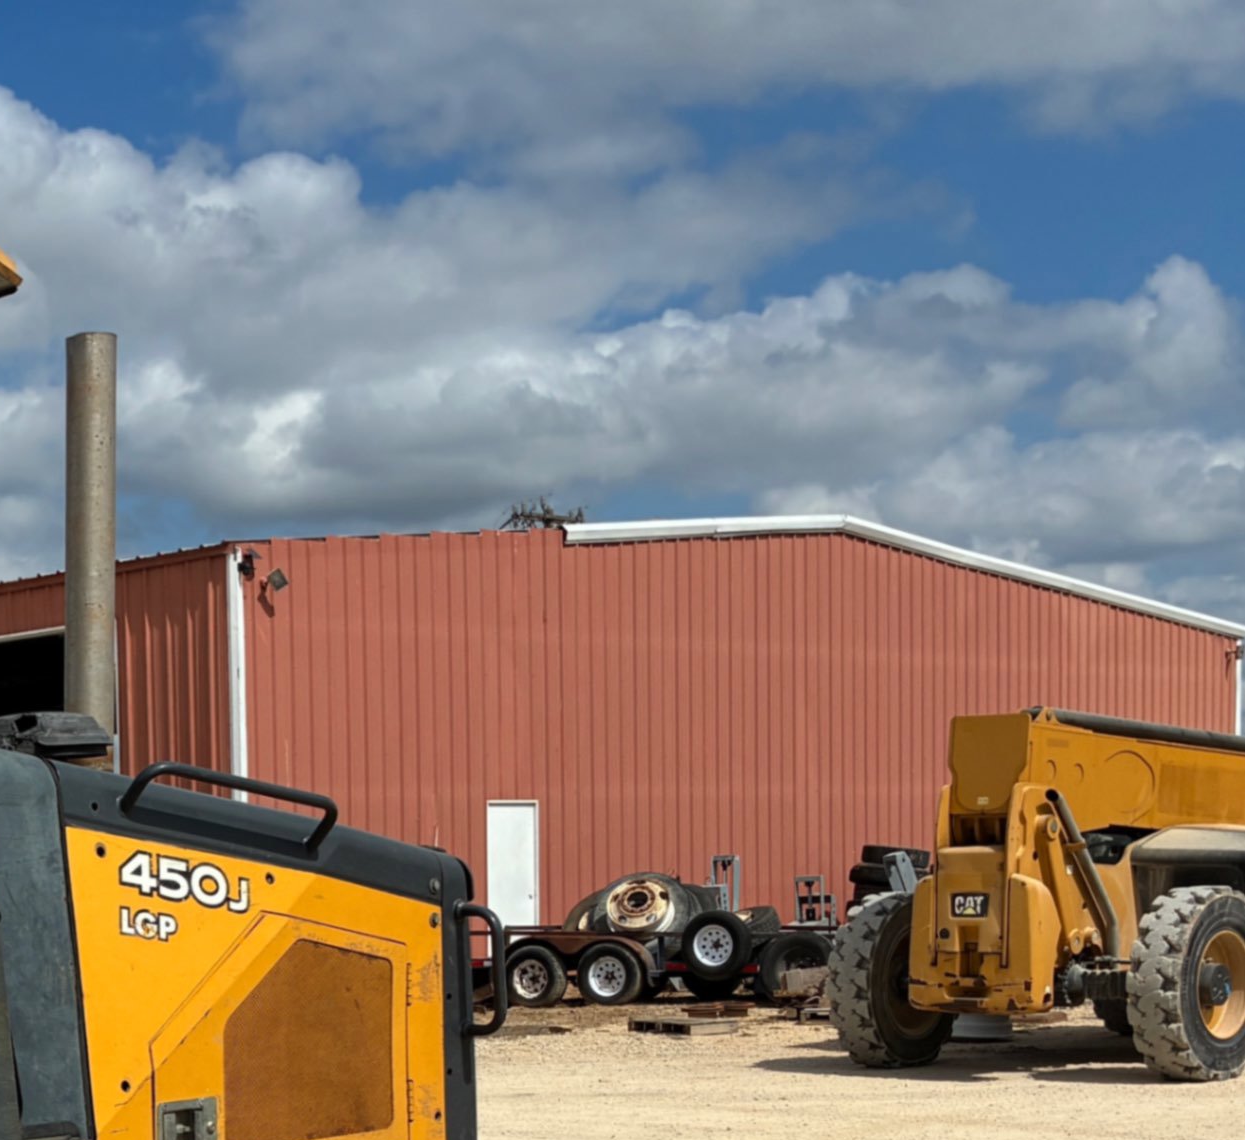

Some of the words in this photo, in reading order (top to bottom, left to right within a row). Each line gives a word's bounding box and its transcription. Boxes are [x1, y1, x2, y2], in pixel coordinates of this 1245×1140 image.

[119, 850, 250, 914] 450J
[954, 895, 984, 915] CAT
[120, 906, 178, 941] LGP
